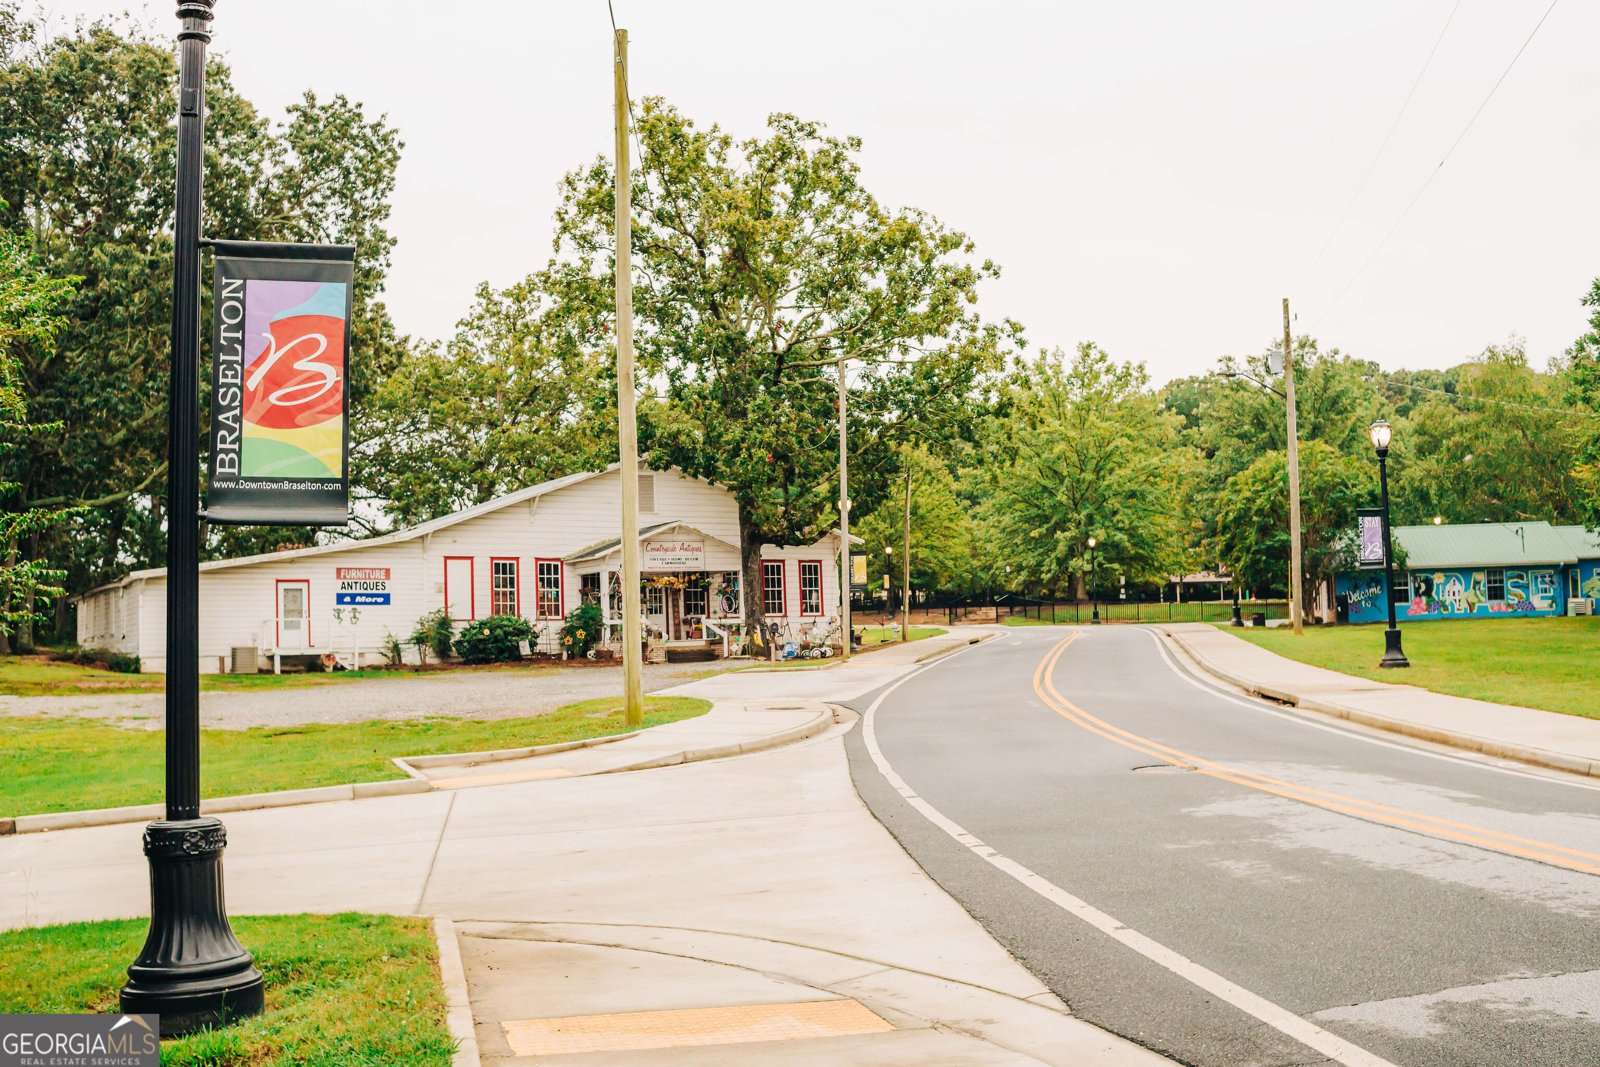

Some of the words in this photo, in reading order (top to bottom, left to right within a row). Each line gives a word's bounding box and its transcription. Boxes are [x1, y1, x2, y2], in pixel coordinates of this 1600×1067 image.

[216, 277, 244, 475] BRASELTON
[213, 479, 341, 491] www.DowntownBraselton.com
[645, 542, 677, 554] Countryside
[679, 542, 702, 555] Antiques
[340, 569, 386, 579] FURNITURE
[340, 582, 386, 591] ANTIQUES
[1344, 585, 1383, 604] Welcome
[1361, 600, 1372, 608] to
